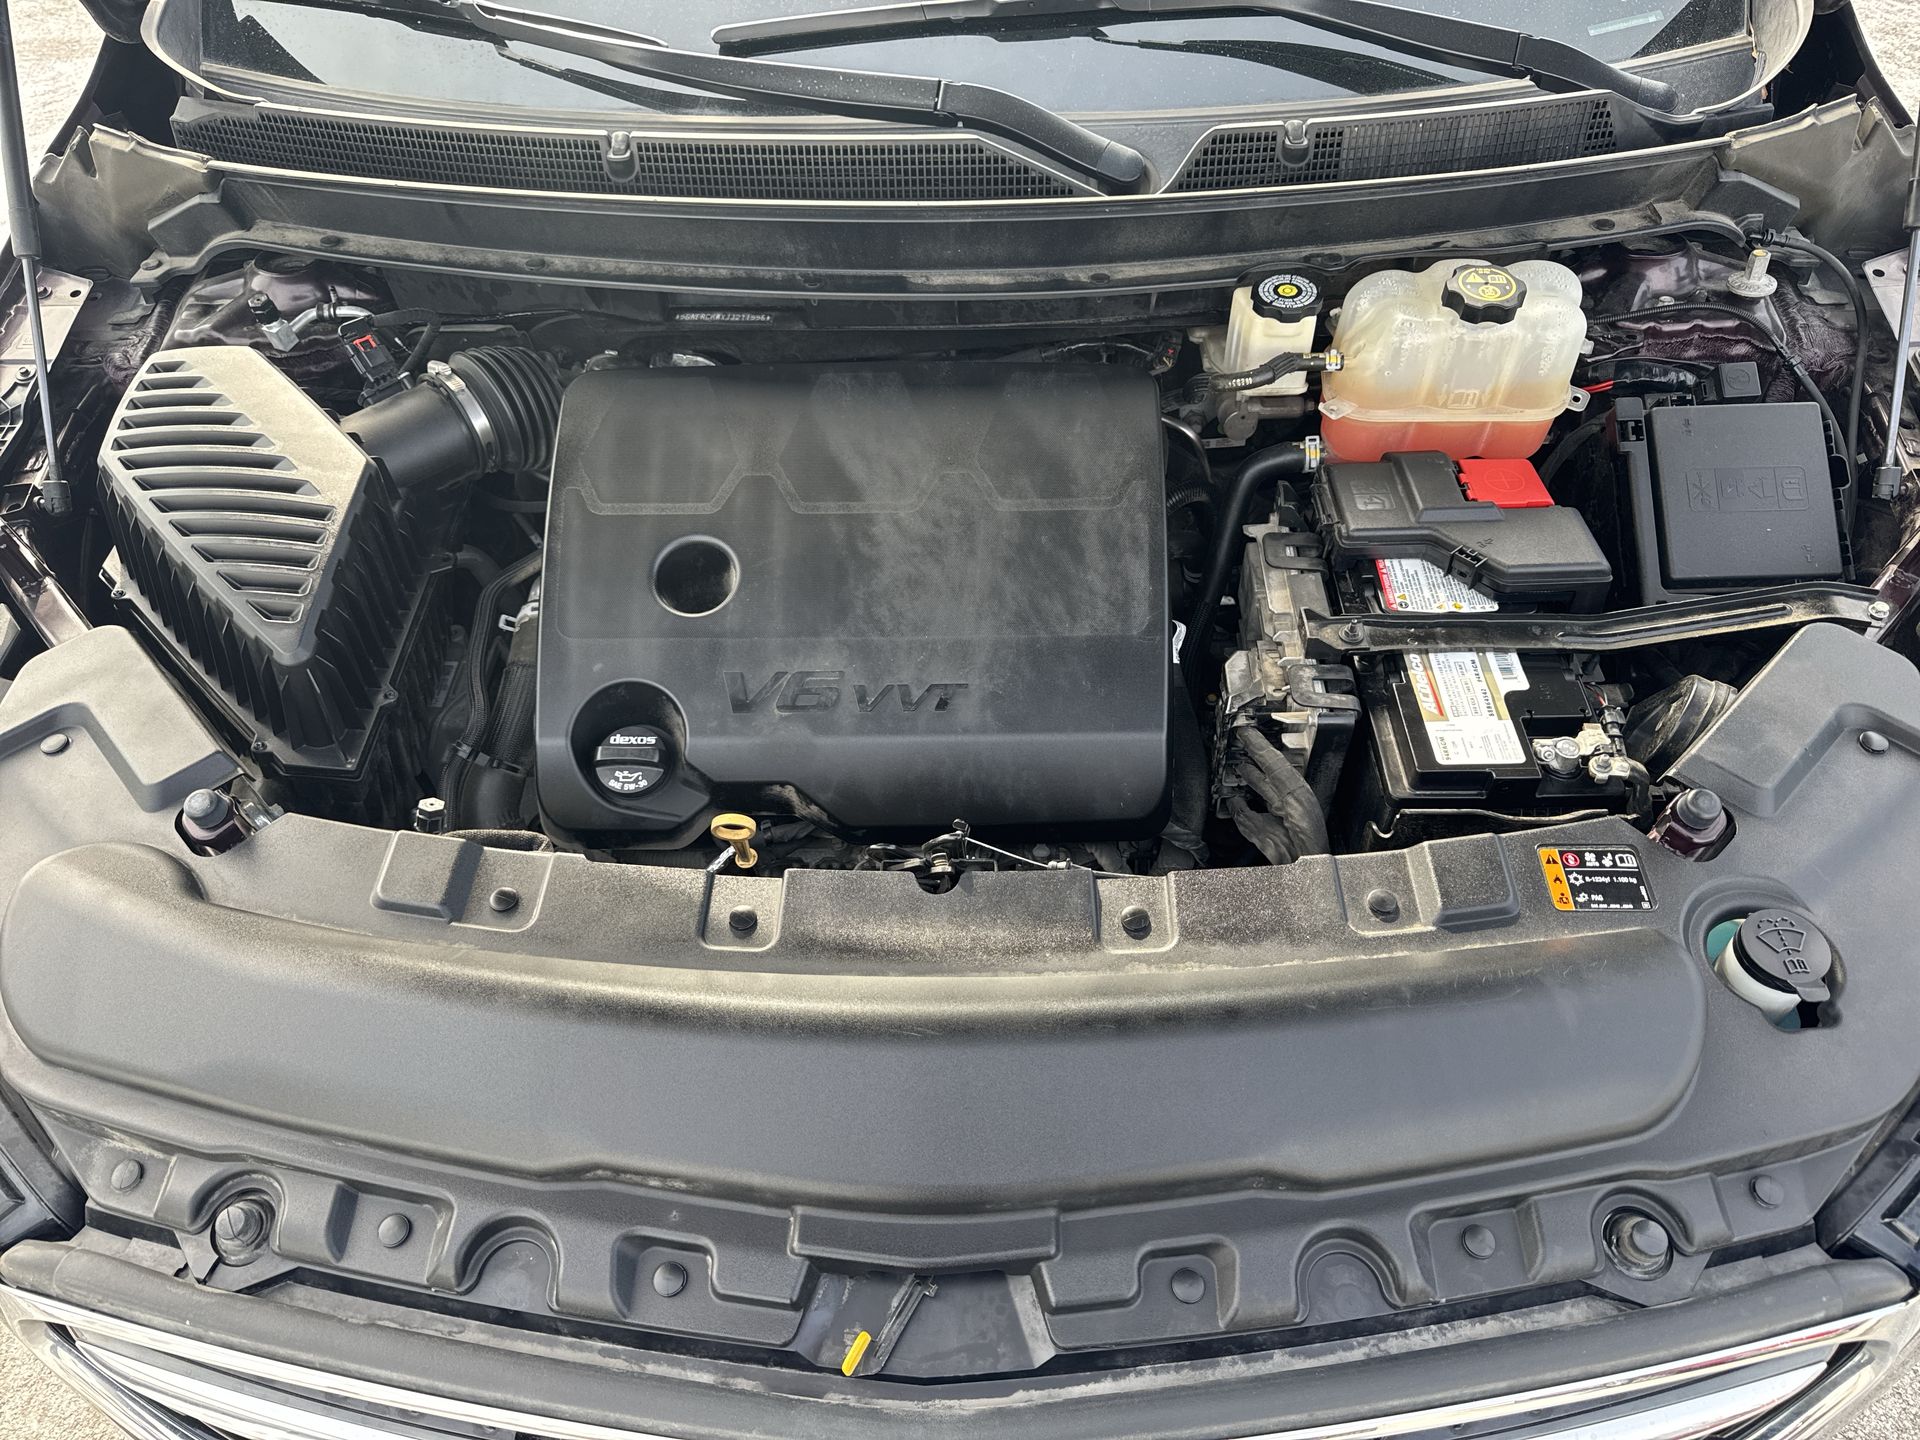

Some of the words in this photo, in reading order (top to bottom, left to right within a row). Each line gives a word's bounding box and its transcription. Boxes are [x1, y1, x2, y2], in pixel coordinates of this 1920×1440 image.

[723, 671, 844, 714] V6
[852, 683, 968, 713] VVT
[609, 733, 658, 744] dexos
[608, 779, 623, 789] SAE
[623, 779, 648, 790] 5W-30
